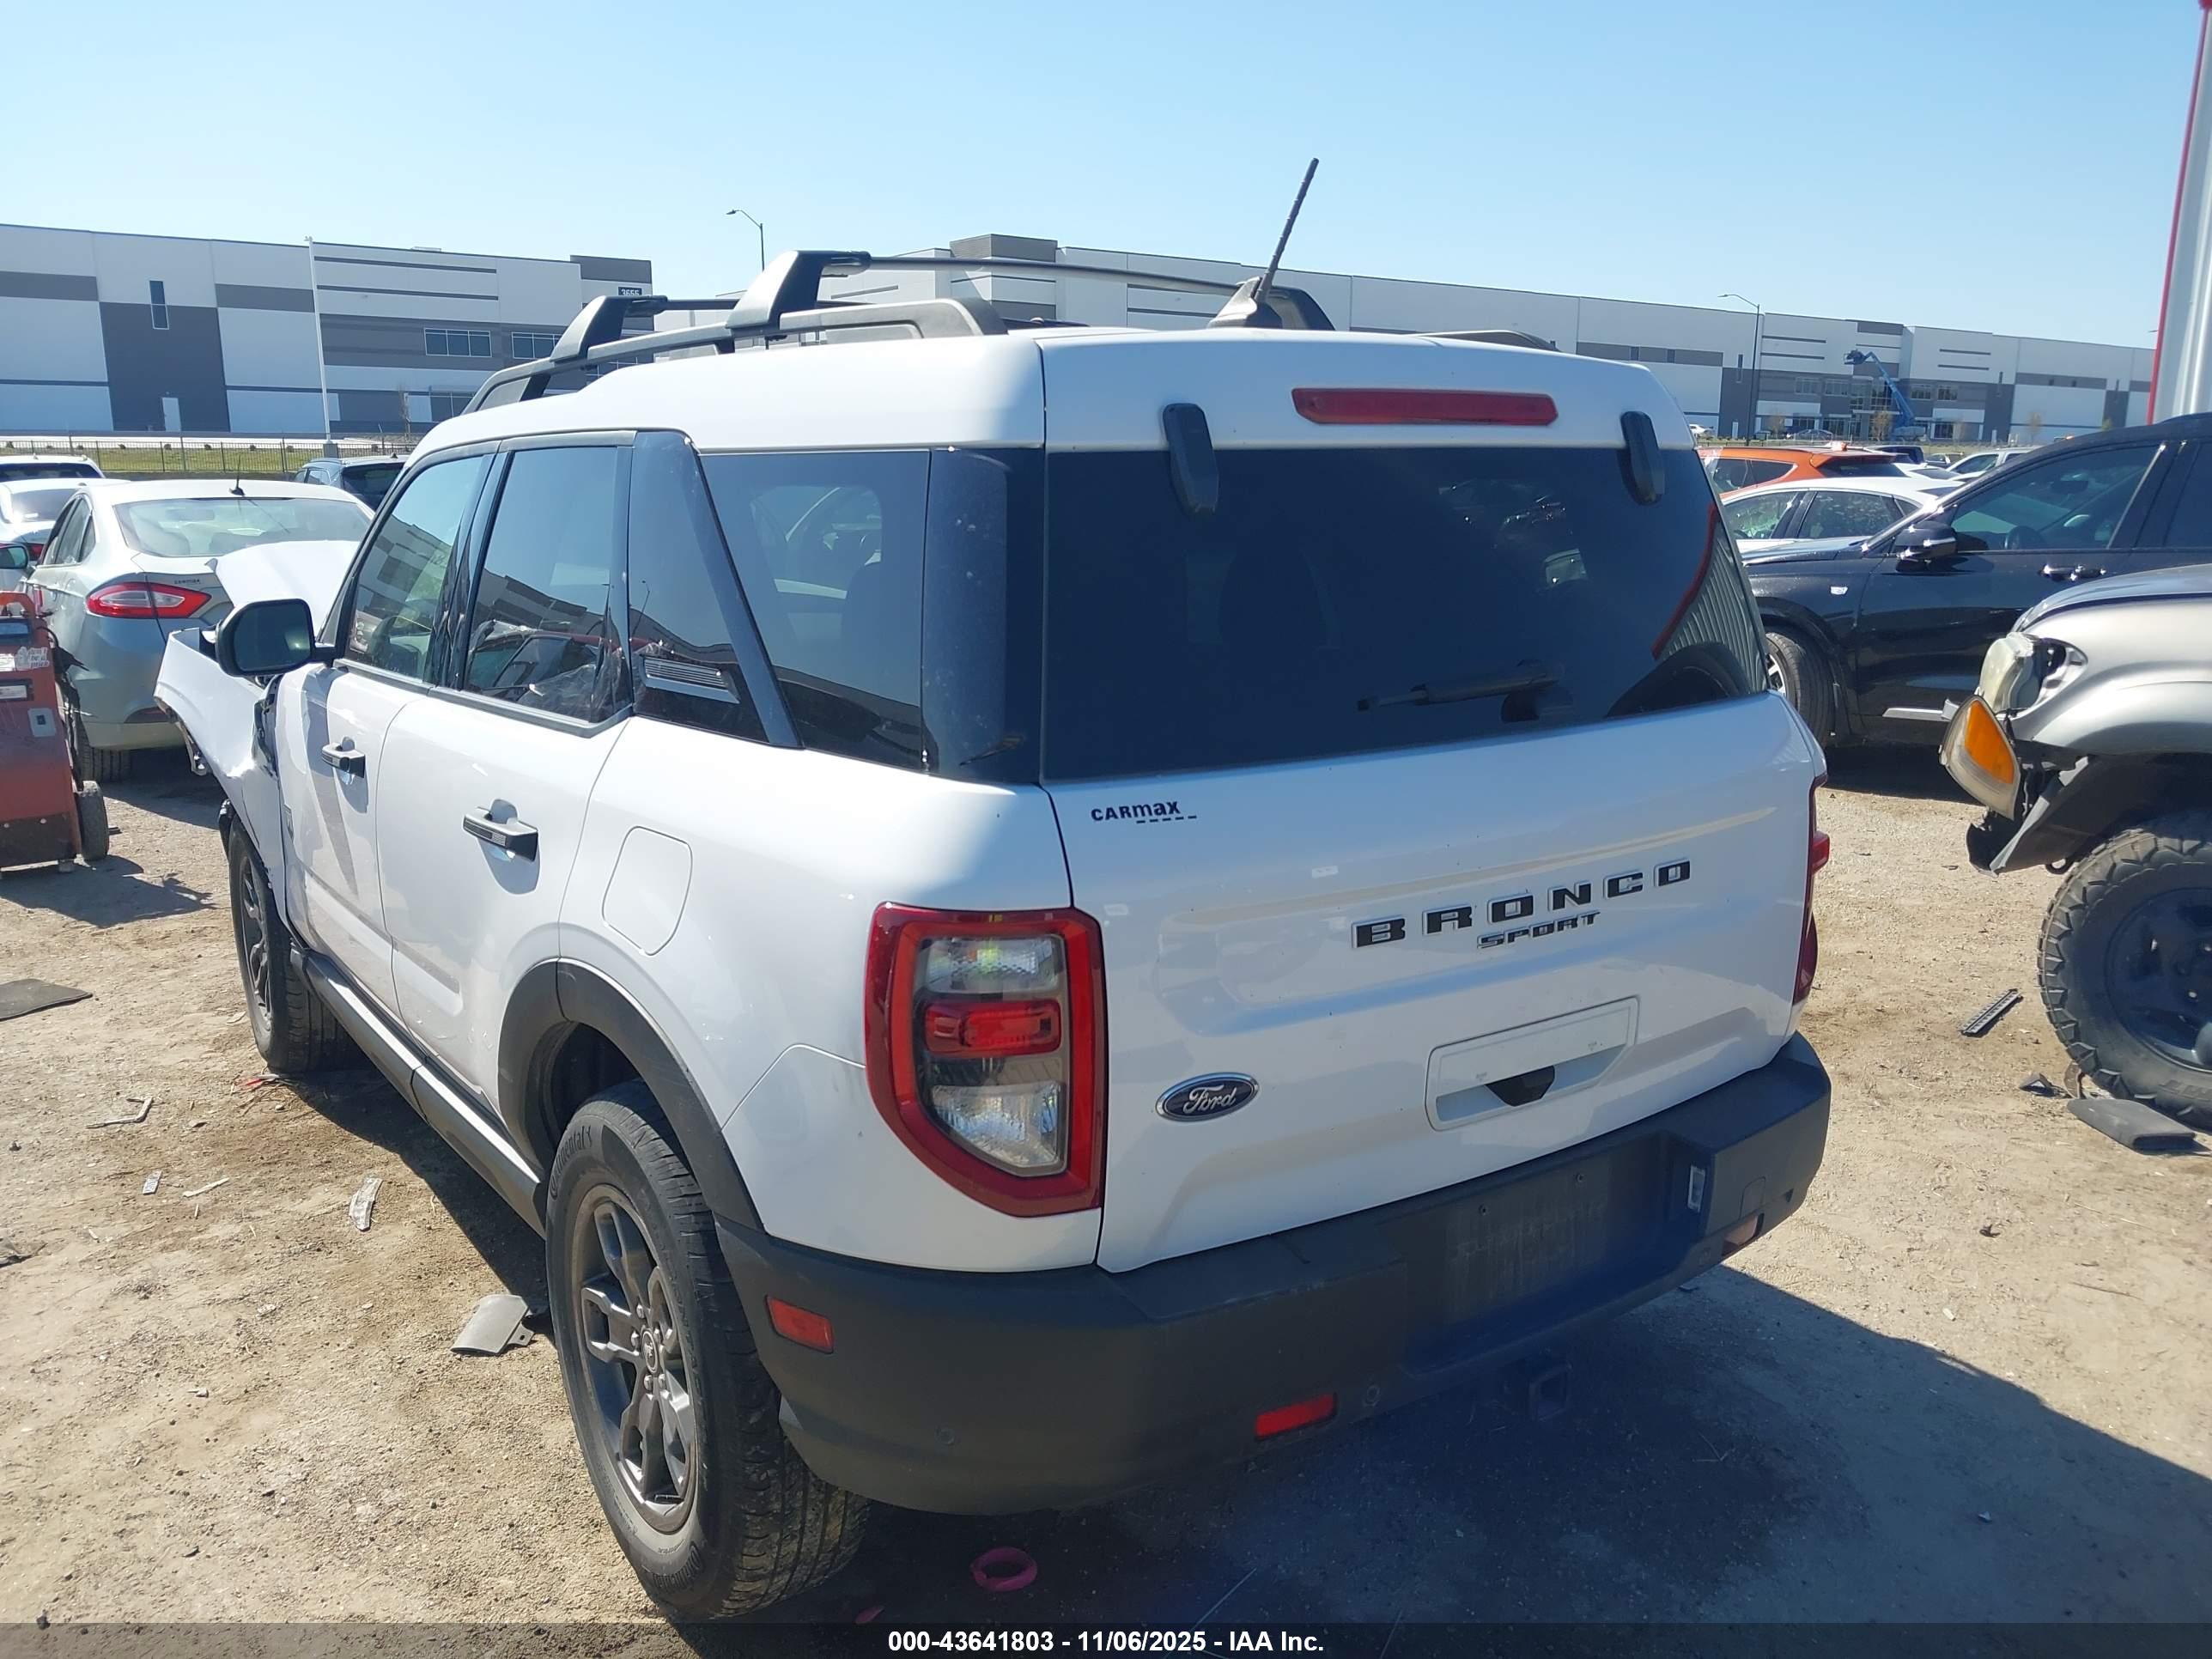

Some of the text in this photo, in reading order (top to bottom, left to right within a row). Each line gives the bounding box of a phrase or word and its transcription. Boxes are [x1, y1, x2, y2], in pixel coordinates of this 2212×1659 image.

[1351, 859, 1692, 949] BRONCO
[1476, 909, 1601, 950] SPORT
[1182, 1083, 1237, 1115] Ford
